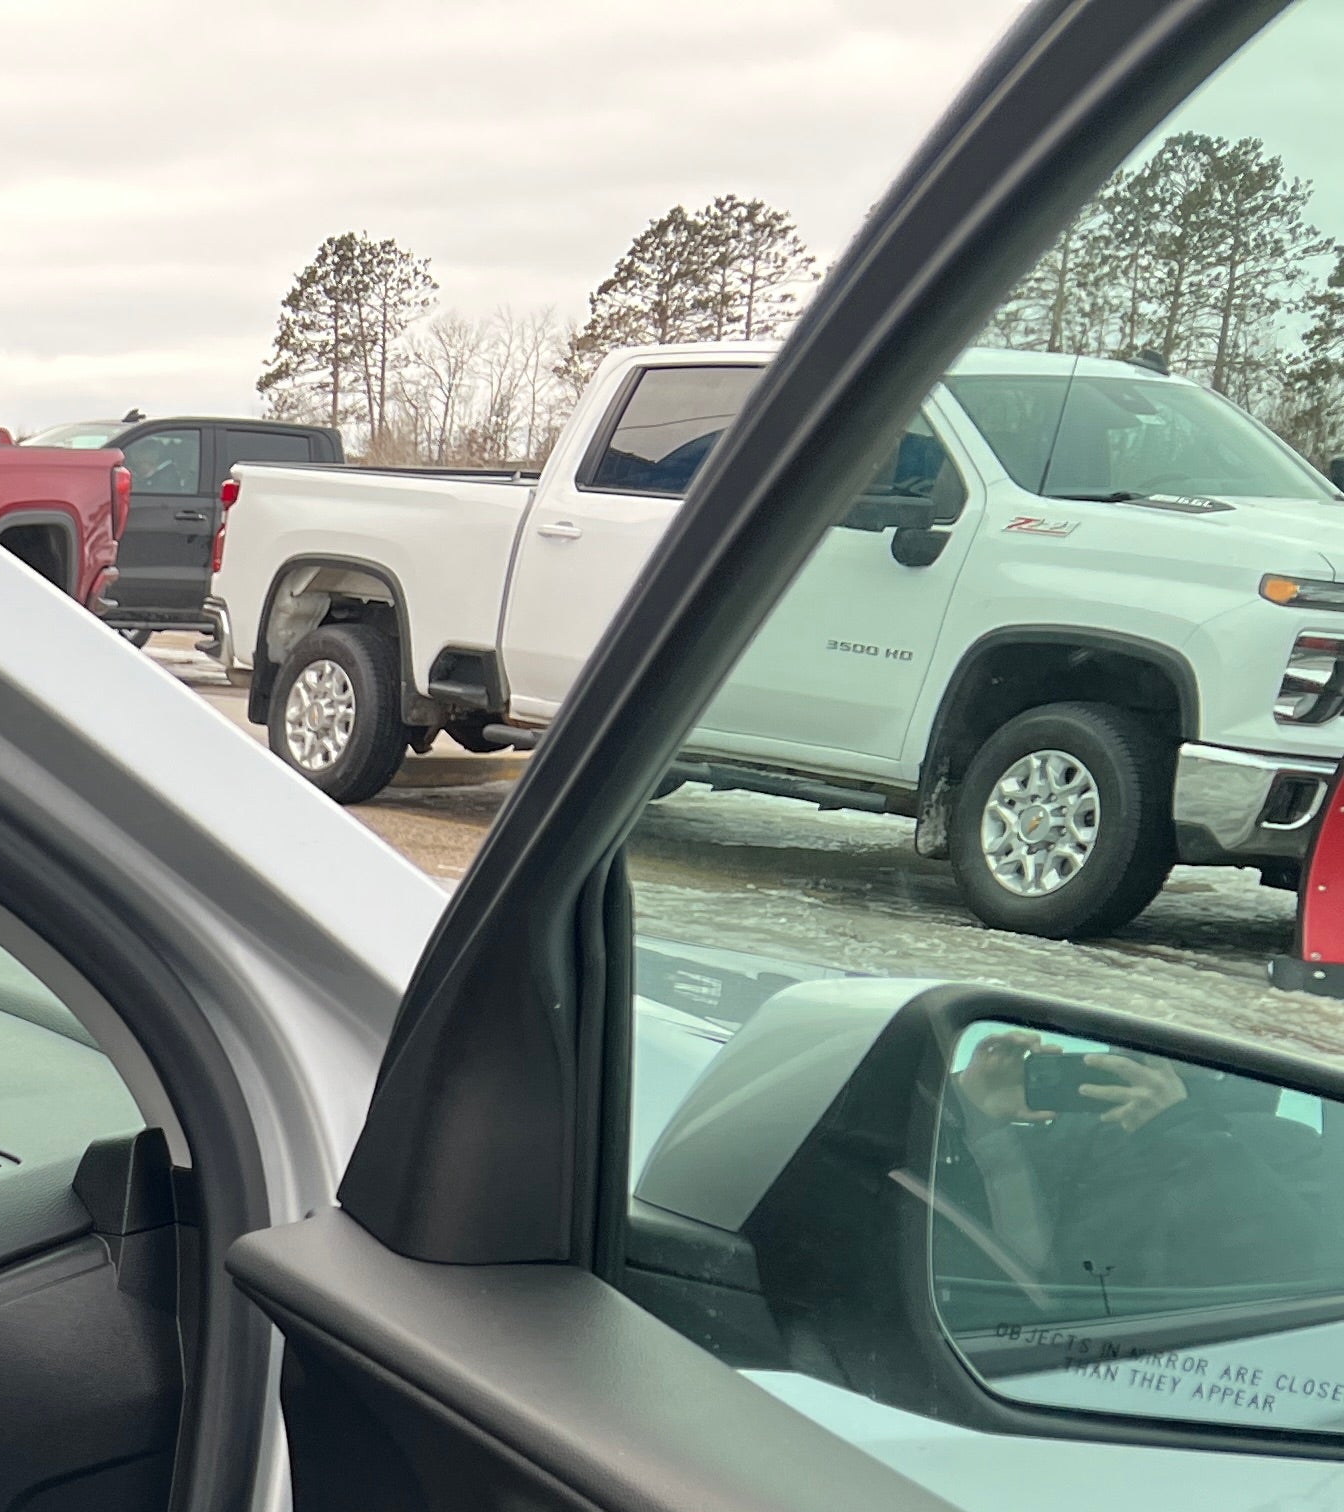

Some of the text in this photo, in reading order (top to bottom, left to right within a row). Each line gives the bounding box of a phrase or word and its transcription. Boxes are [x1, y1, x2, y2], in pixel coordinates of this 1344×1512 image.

[825, 638, 914, 662] 3500 HD
[996, 1321, 1093, 1354] OBJECTS
[1099, 1341, 1121, 1359] IN
[1129, 1346, 1209, 1376] MIRROR
[1219, 1364, 1265, 1387] ARE
[1064, 1355, 1276, 1413] THAN THEY APPEAR
